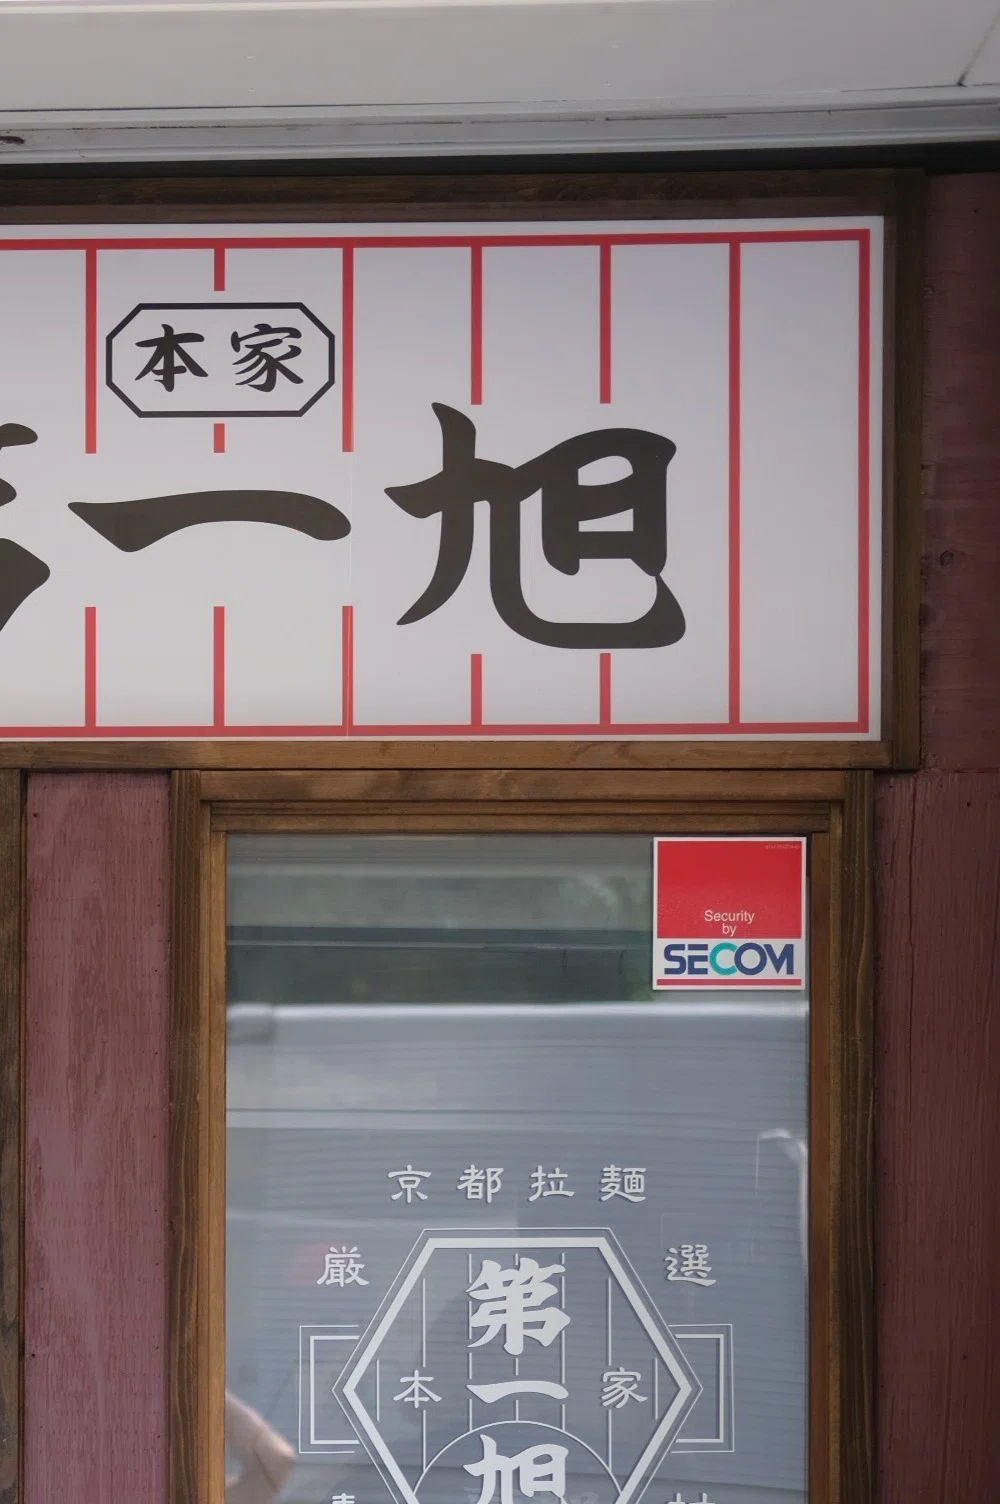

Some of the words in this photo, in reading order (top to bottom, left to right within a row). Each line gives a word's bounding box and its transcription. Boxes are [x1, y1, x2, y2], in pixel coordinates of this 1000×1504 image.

[134, 323, 304, 393] 本家
[704, 909, 755, 924] Security
[722, 923, 737, 936] by
[663, 942, 794, 976] SECOM
[387, 1164, 647, 1203] 京都拉麺
[317, 1246, 369, 1288] 厳
[664, 1244, 717, 1288] 選
[393, 1370, 442, 1408] 本
[600, 1367, 649, 1408] 家
